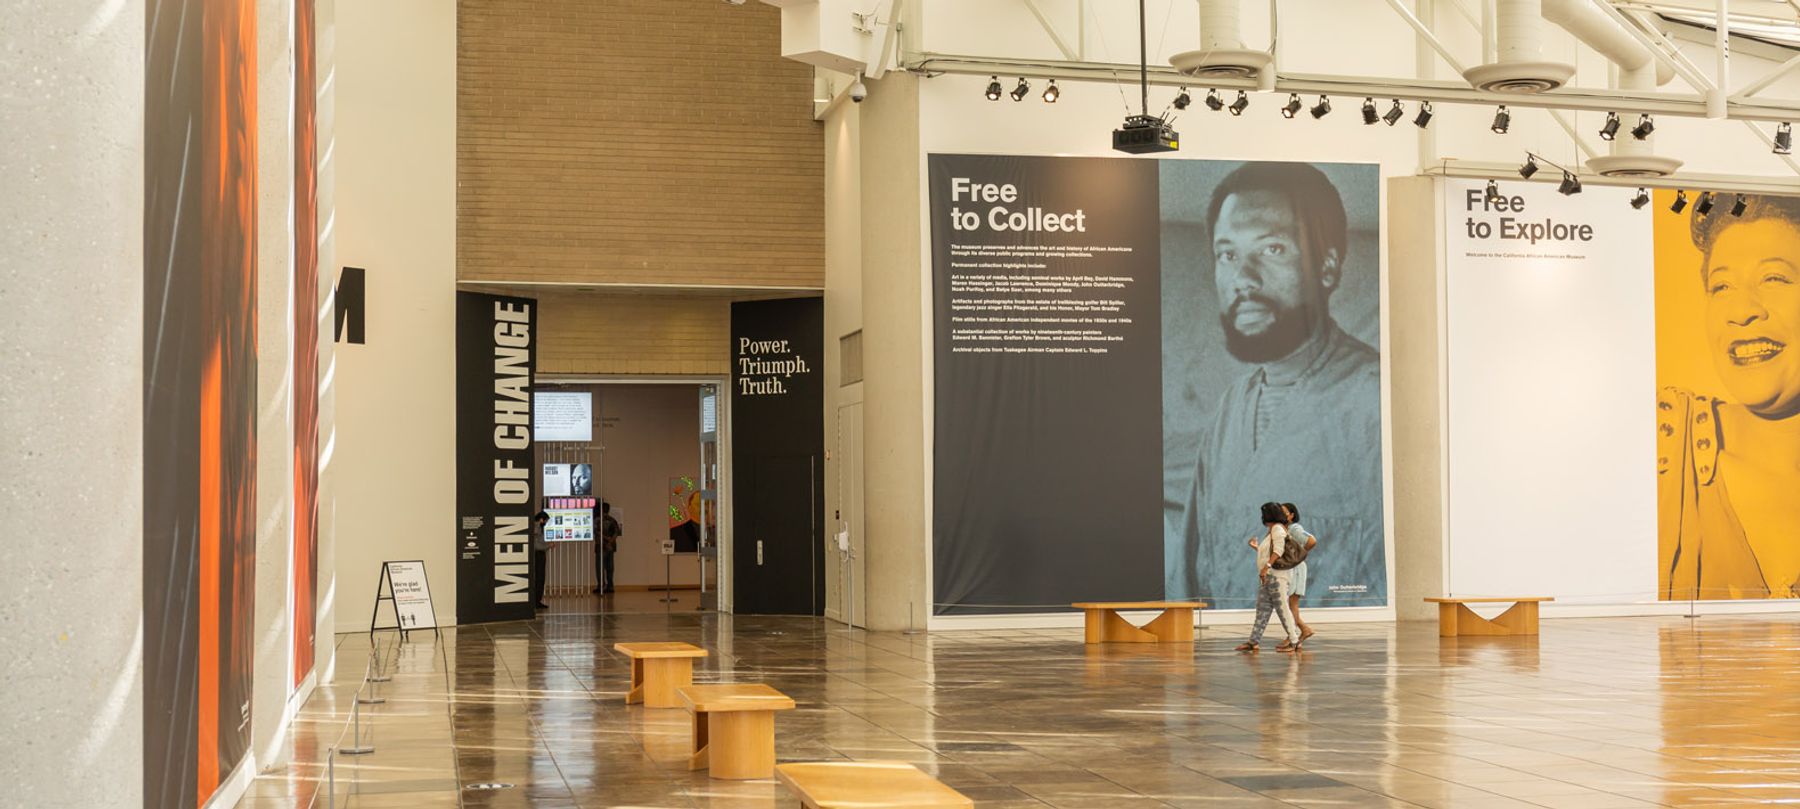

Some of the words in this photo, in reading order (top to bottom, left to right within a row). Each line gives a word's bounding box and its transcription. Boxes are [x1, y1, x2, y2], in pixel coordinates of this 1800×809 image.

[951, 177, 1018, 203] Free
[1466, 189, 1525, 212] Free
[950, 207, 980, 231] to
[988, 206, 1086, 232] Collect
[1466, 217, 1492, 239] to
[1500, 217, 1593, 245] Explore
[739, 337, 791, 355] Power.
[494, 301, 530, 450] CHANGE
[739, 356, 810, 378] Triumph.
[739, 376, 787, 395] Truth.
[494, 459, 530, 505] OF
[494, 516, 529, 604] MEN
